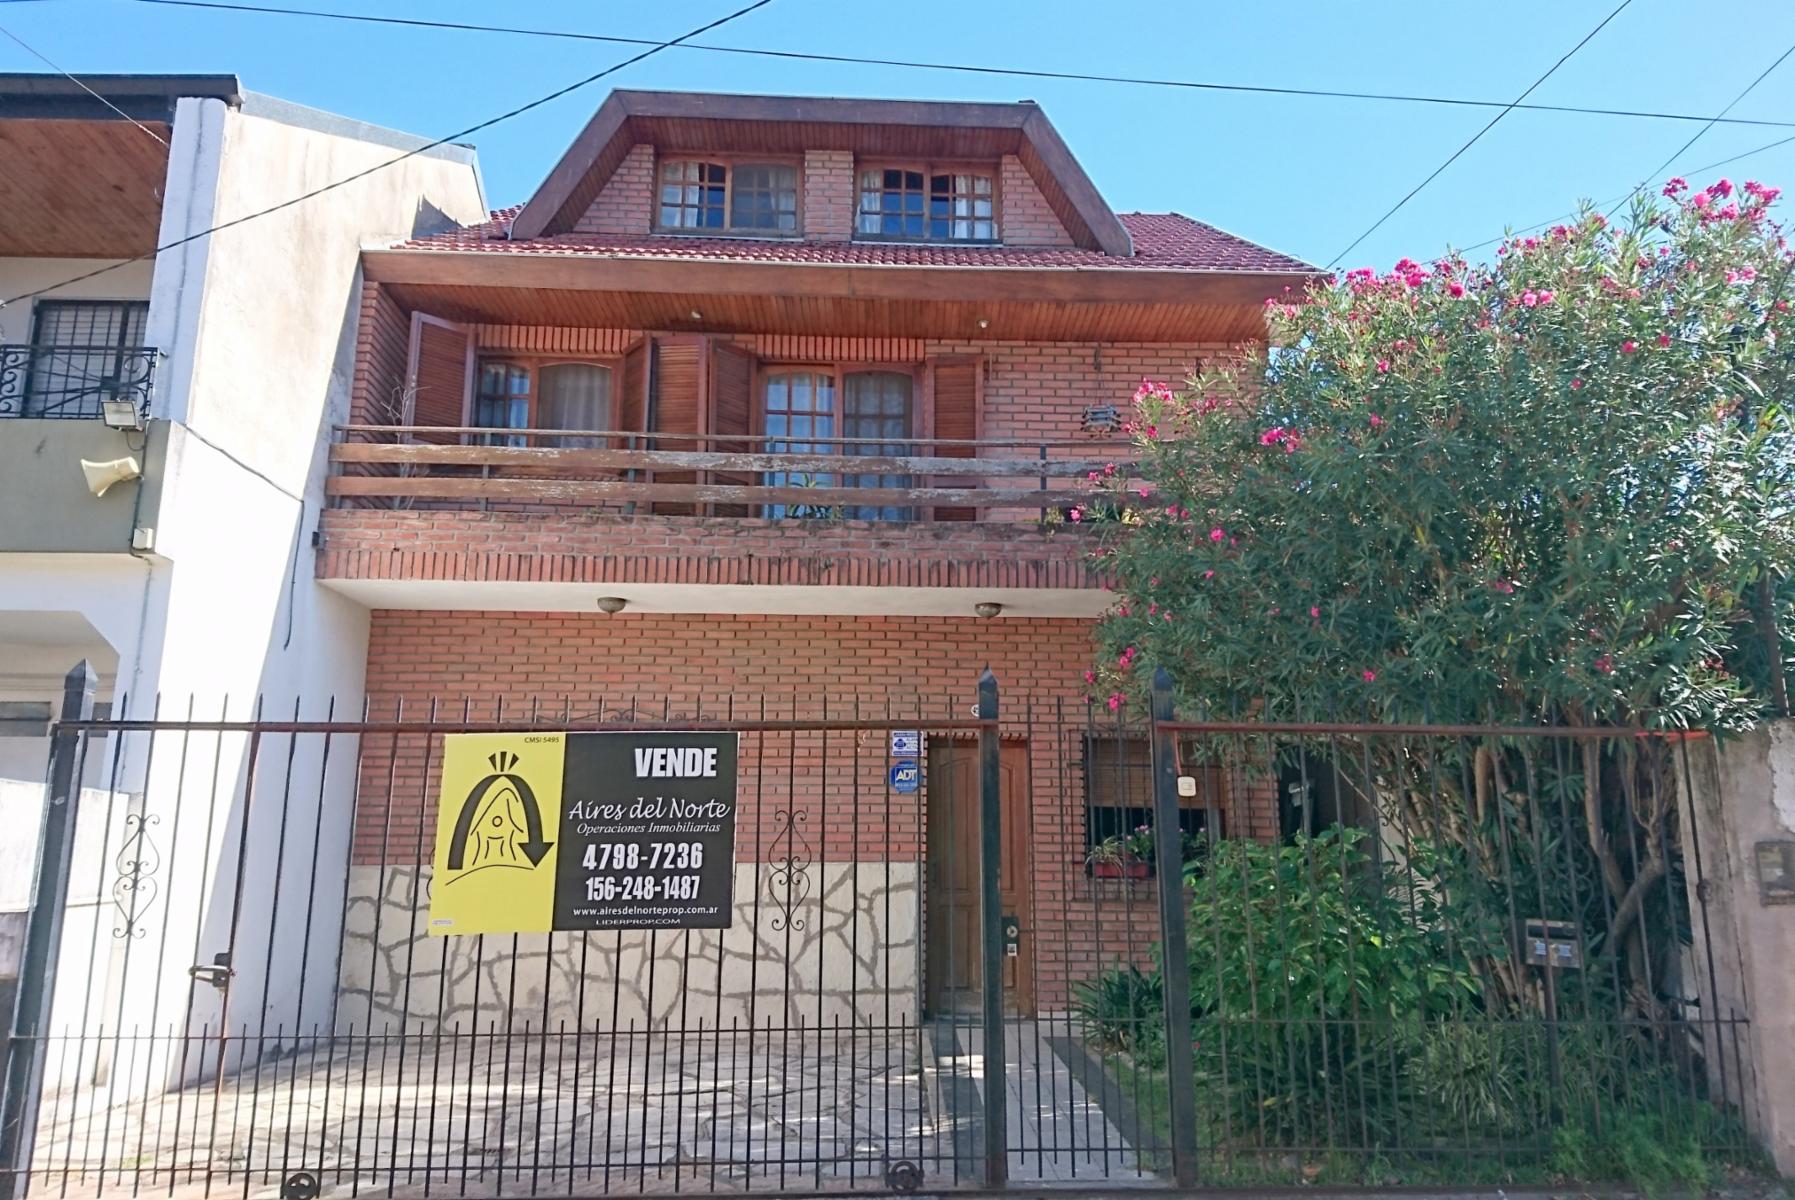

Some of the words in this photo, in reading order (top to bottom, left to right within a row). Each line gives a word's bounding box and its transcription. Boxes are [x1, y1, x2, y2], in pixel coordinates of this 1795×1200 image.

[634, 747, 717, 778] VENDE
[896, 769, 917, 780] ADT
[568, 799, 627, 821] Aires
[629, 796, 667, 819] del
[668, 797, 731, 819] Norte
[576, 822, 645, 836] Operaciones
[647, 821, 721, 833] Inmobiliarias
[582, 842, 704, 870] 4798-7236
[585, 875, 701, 901] 156-248-1487
[573, 906, 718, 916] www.airesdelnorteprop.com.ar
